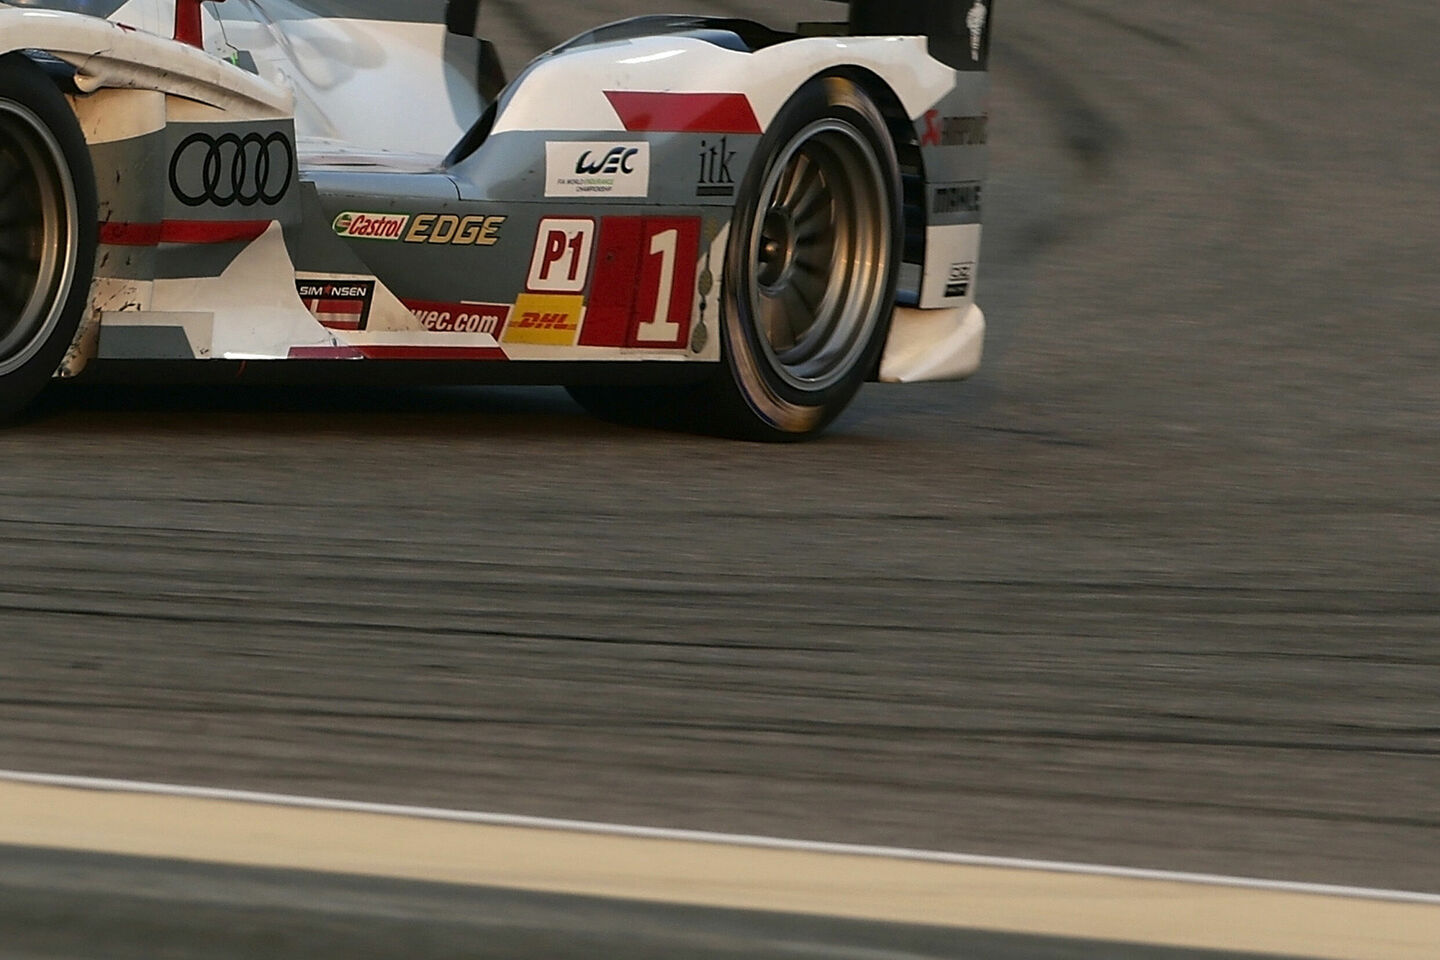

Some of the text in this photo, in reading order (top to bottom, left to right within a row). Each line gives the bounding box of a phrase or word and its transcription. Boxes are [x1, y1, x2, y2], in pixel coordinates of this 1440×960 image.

[575, 146, 639, 174] WEC
[697, 136, 737, 184] itk
[349, 214, 506, 245] Castrol EDGE
[539, 230, 584, 281] P1
[636, 228, 680, 342] 1
[518, 312, 570, 329] DHL
